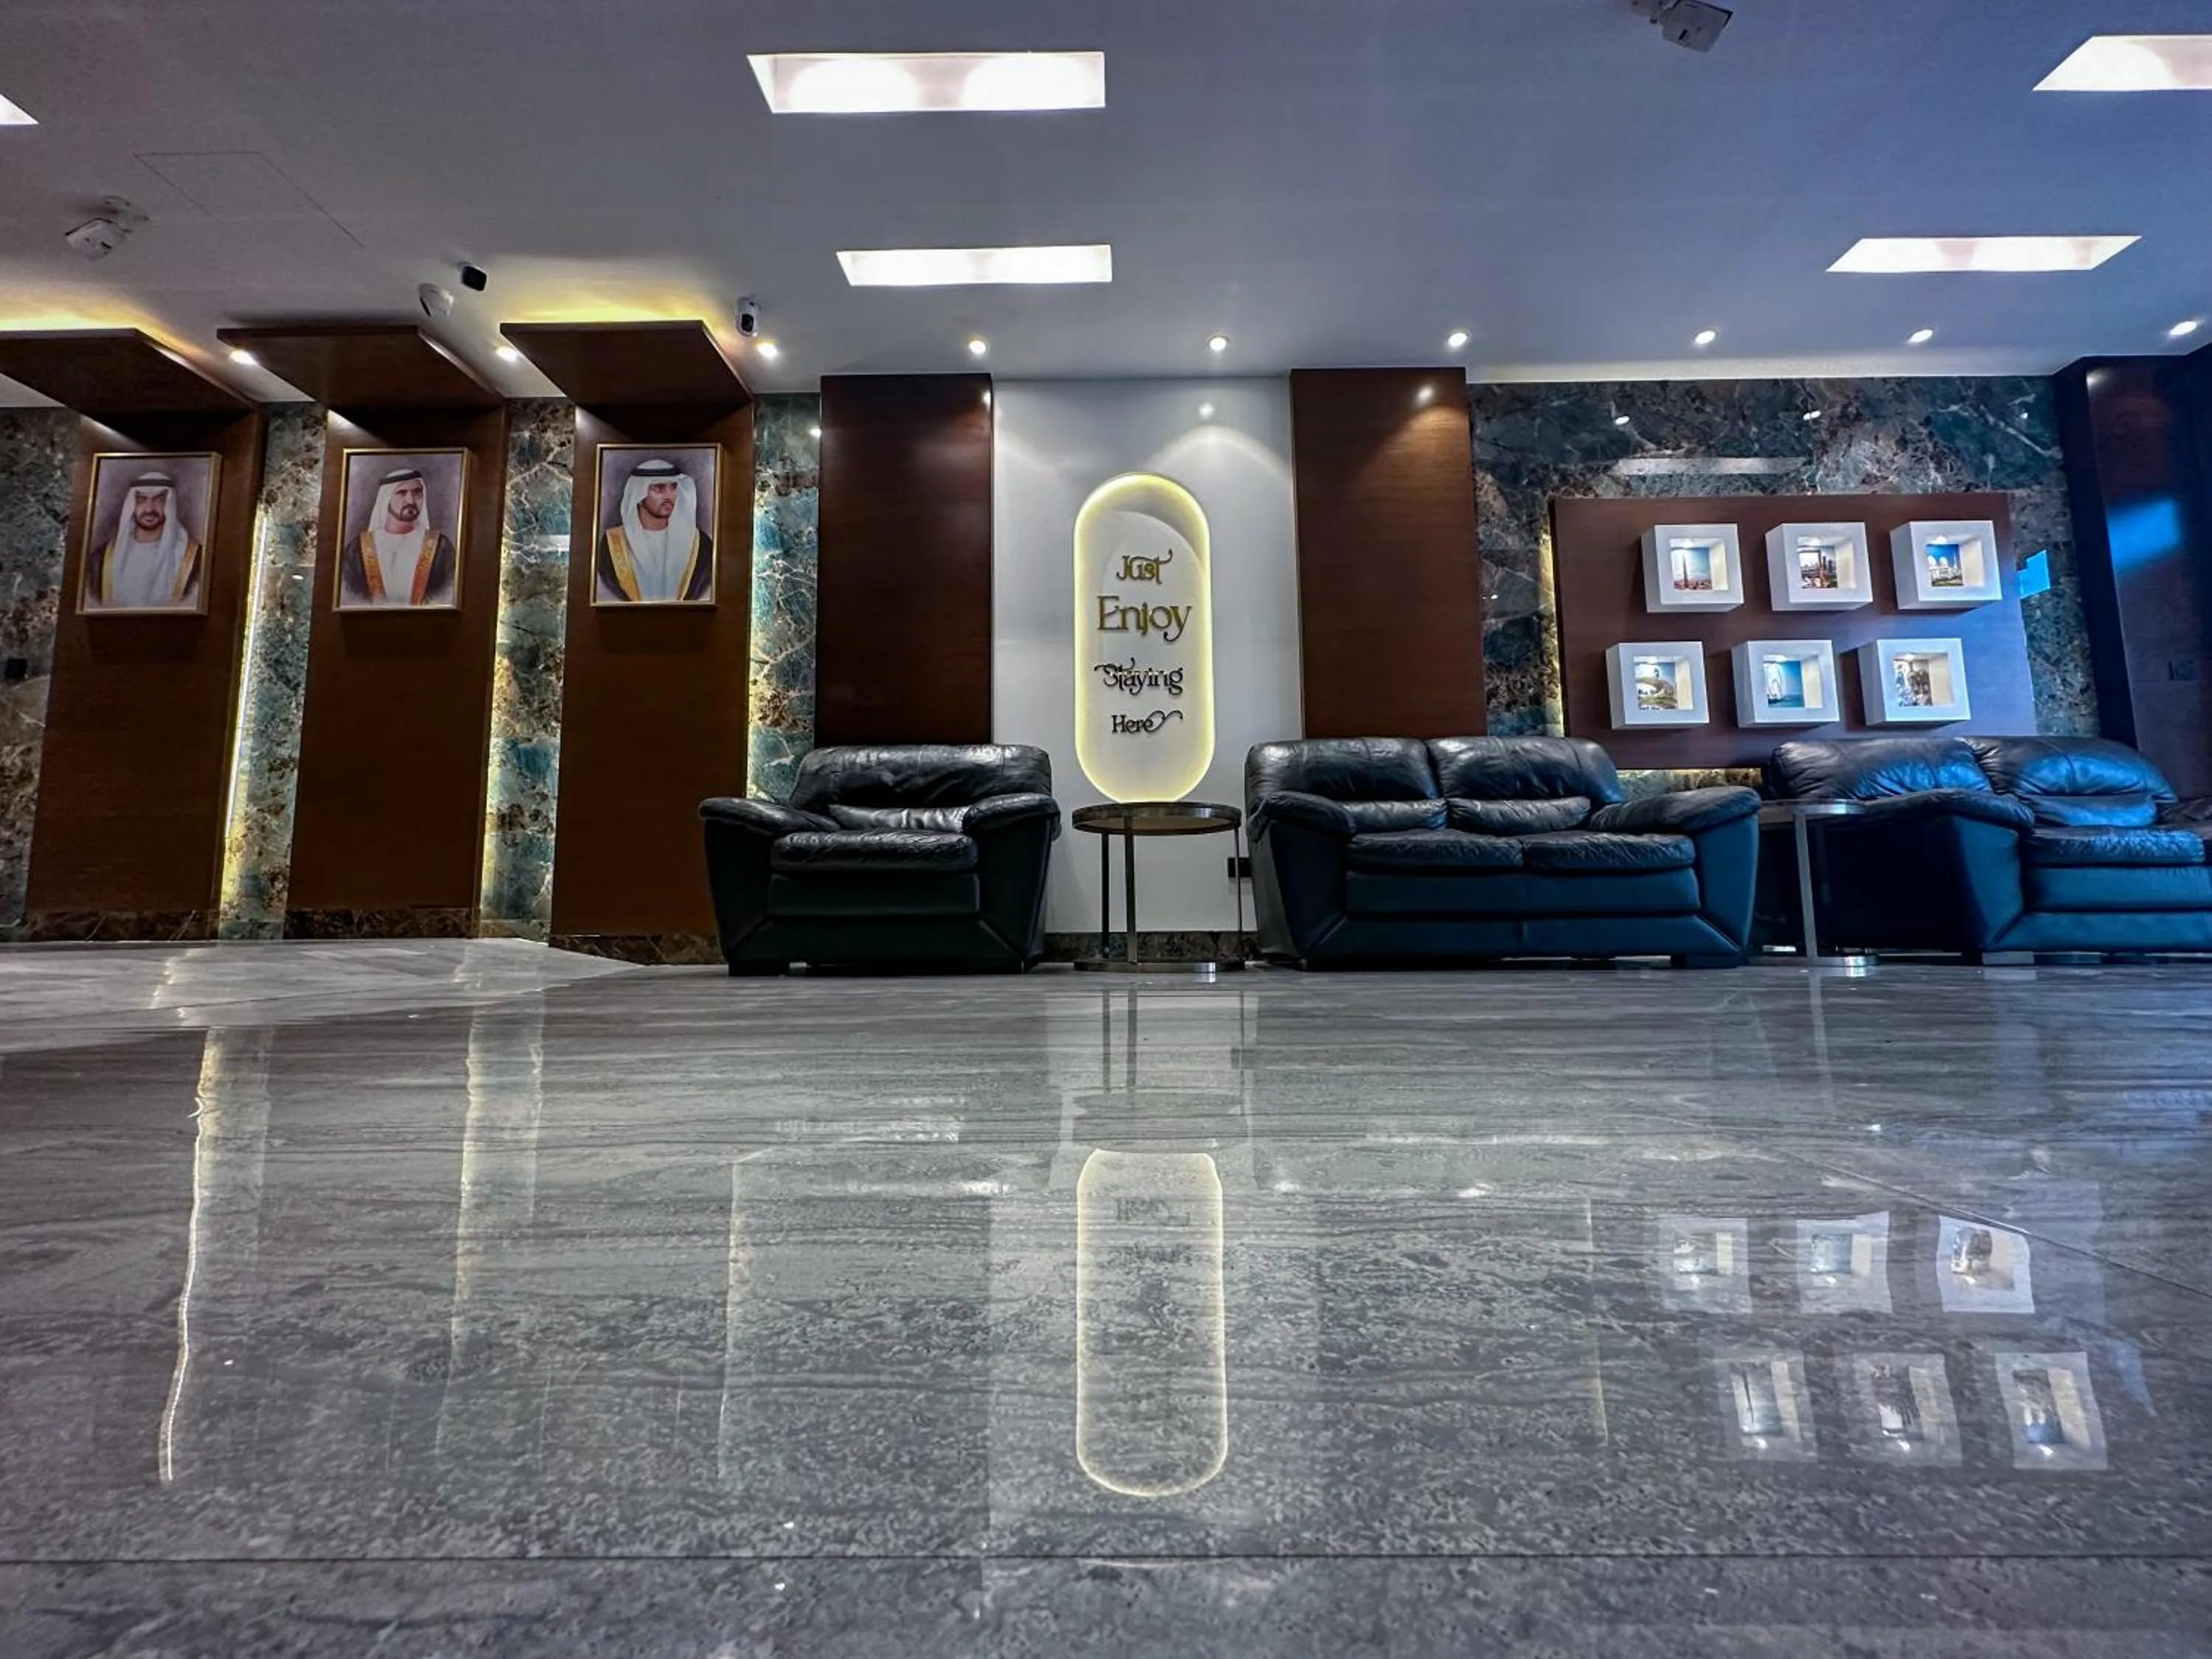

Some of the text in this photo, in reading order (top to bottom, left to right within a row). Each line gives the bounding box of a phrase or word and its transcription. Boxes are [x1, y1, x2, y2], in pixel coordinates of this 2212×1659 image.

[1116, 549, 1172, 584] Just
[1097, 595, 1192, 642] Enjoy
[1093, 657, 1183, 695] Staying
[1111, 710, 1183, 734] Here
